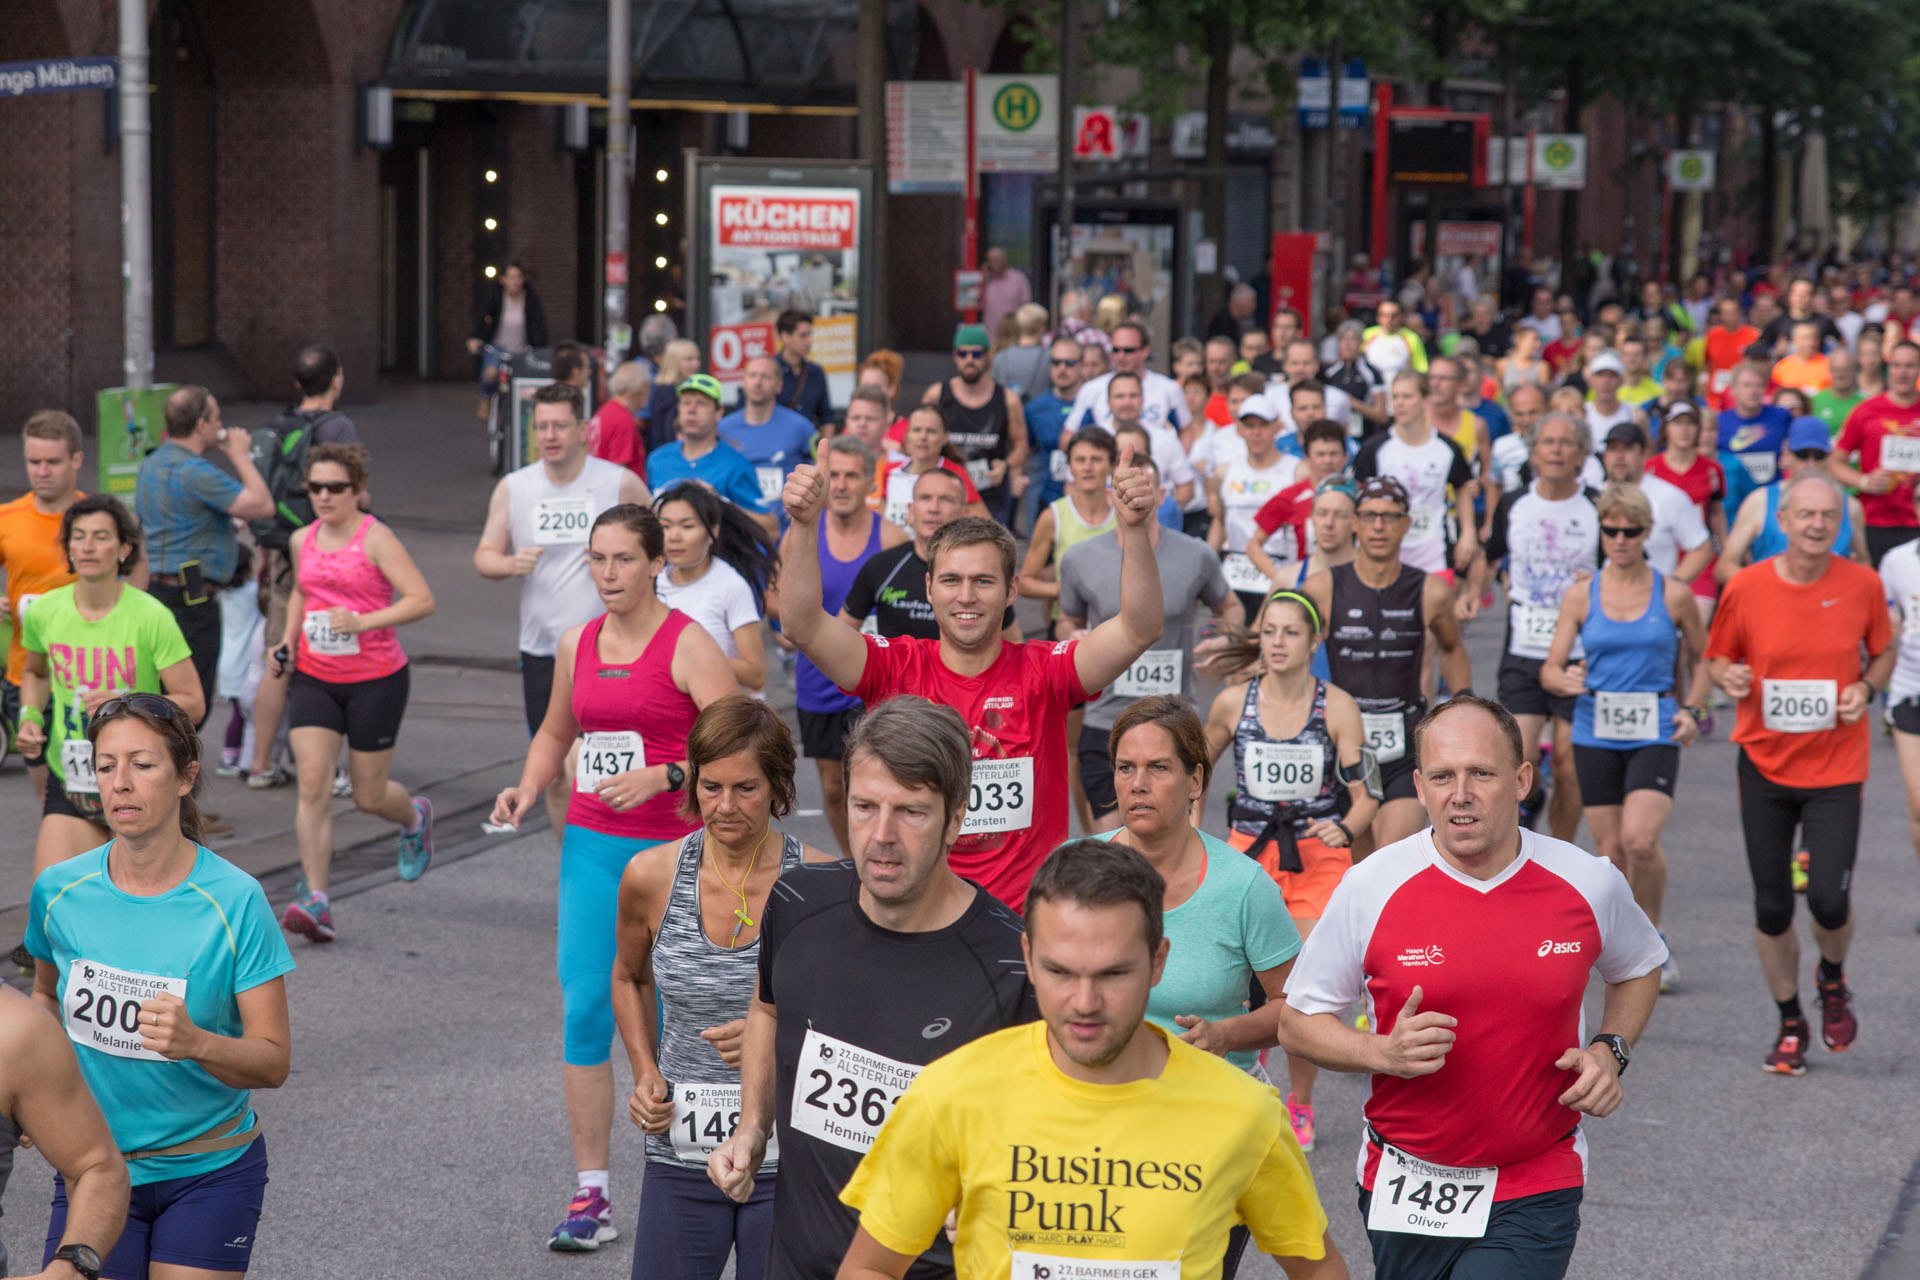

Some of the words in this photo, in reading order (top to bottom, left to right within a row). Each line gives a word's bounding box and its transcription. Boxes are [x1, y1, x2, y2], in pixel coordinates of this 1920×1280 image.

[37, 62, 115, 88] Mühren
[723, 197, 850, 230] KÜCHEN
[712, 330, 742, 370] 0
[539, 511, 589, 531] 2200
[48, 643, 137, 692] RUN
[1125, 664, 1176, 683] 1043
[1601, 707, 1652, 726] 1547
[1769, 696, 1829, 718] 2060
[583, 750, 635, 775] 1437
[1005, 762, 1021, 770] GEK
[1252, 761, 1314, 785] 1908
[973, 769, 1021, 781] STERLAUF
[967, 781, 1025, 813] 033
[963, 816, 1007, 828] Carsten
[1397, 953, 1426, 961] Marathon
[1552, 941, 1582, 954] asics
[1402, 959, 1429, 967] Hamburg
[109, 973, 150, 988] BARMER
[149, 981, 169, 990] GEK
[73, 988, 142, 1034] 200
[93, 1030, 142, 1051] Melanie
[837, 1059, 913, 1091] ALSTERLAU
[852, 1052, 895, 1074] BARMER
[895, 1068, 918, 1080] GEK
[700, 1097, 741, 1108] ALSTER
[711, 1089, 741, 1097] BARME
[804, 1068, 903, 1127] 236
[823, 1118, 876, 1146] Hennin
[1006, 1144, 1203, 1194] Business
[1388, 1174, 1485, 1215] 1487
[1006, 1188, 1126, 1234] Punk
[1407, 1213, 1449, 1230] Oliver
[1066, 1235, 1095, 1245] PLAY
[1058, 1264, 1074, 1276] 27.
[1075, 1266, 1131, 1279] BARMER
[1133, 1268, 1159, 1279] GEK
